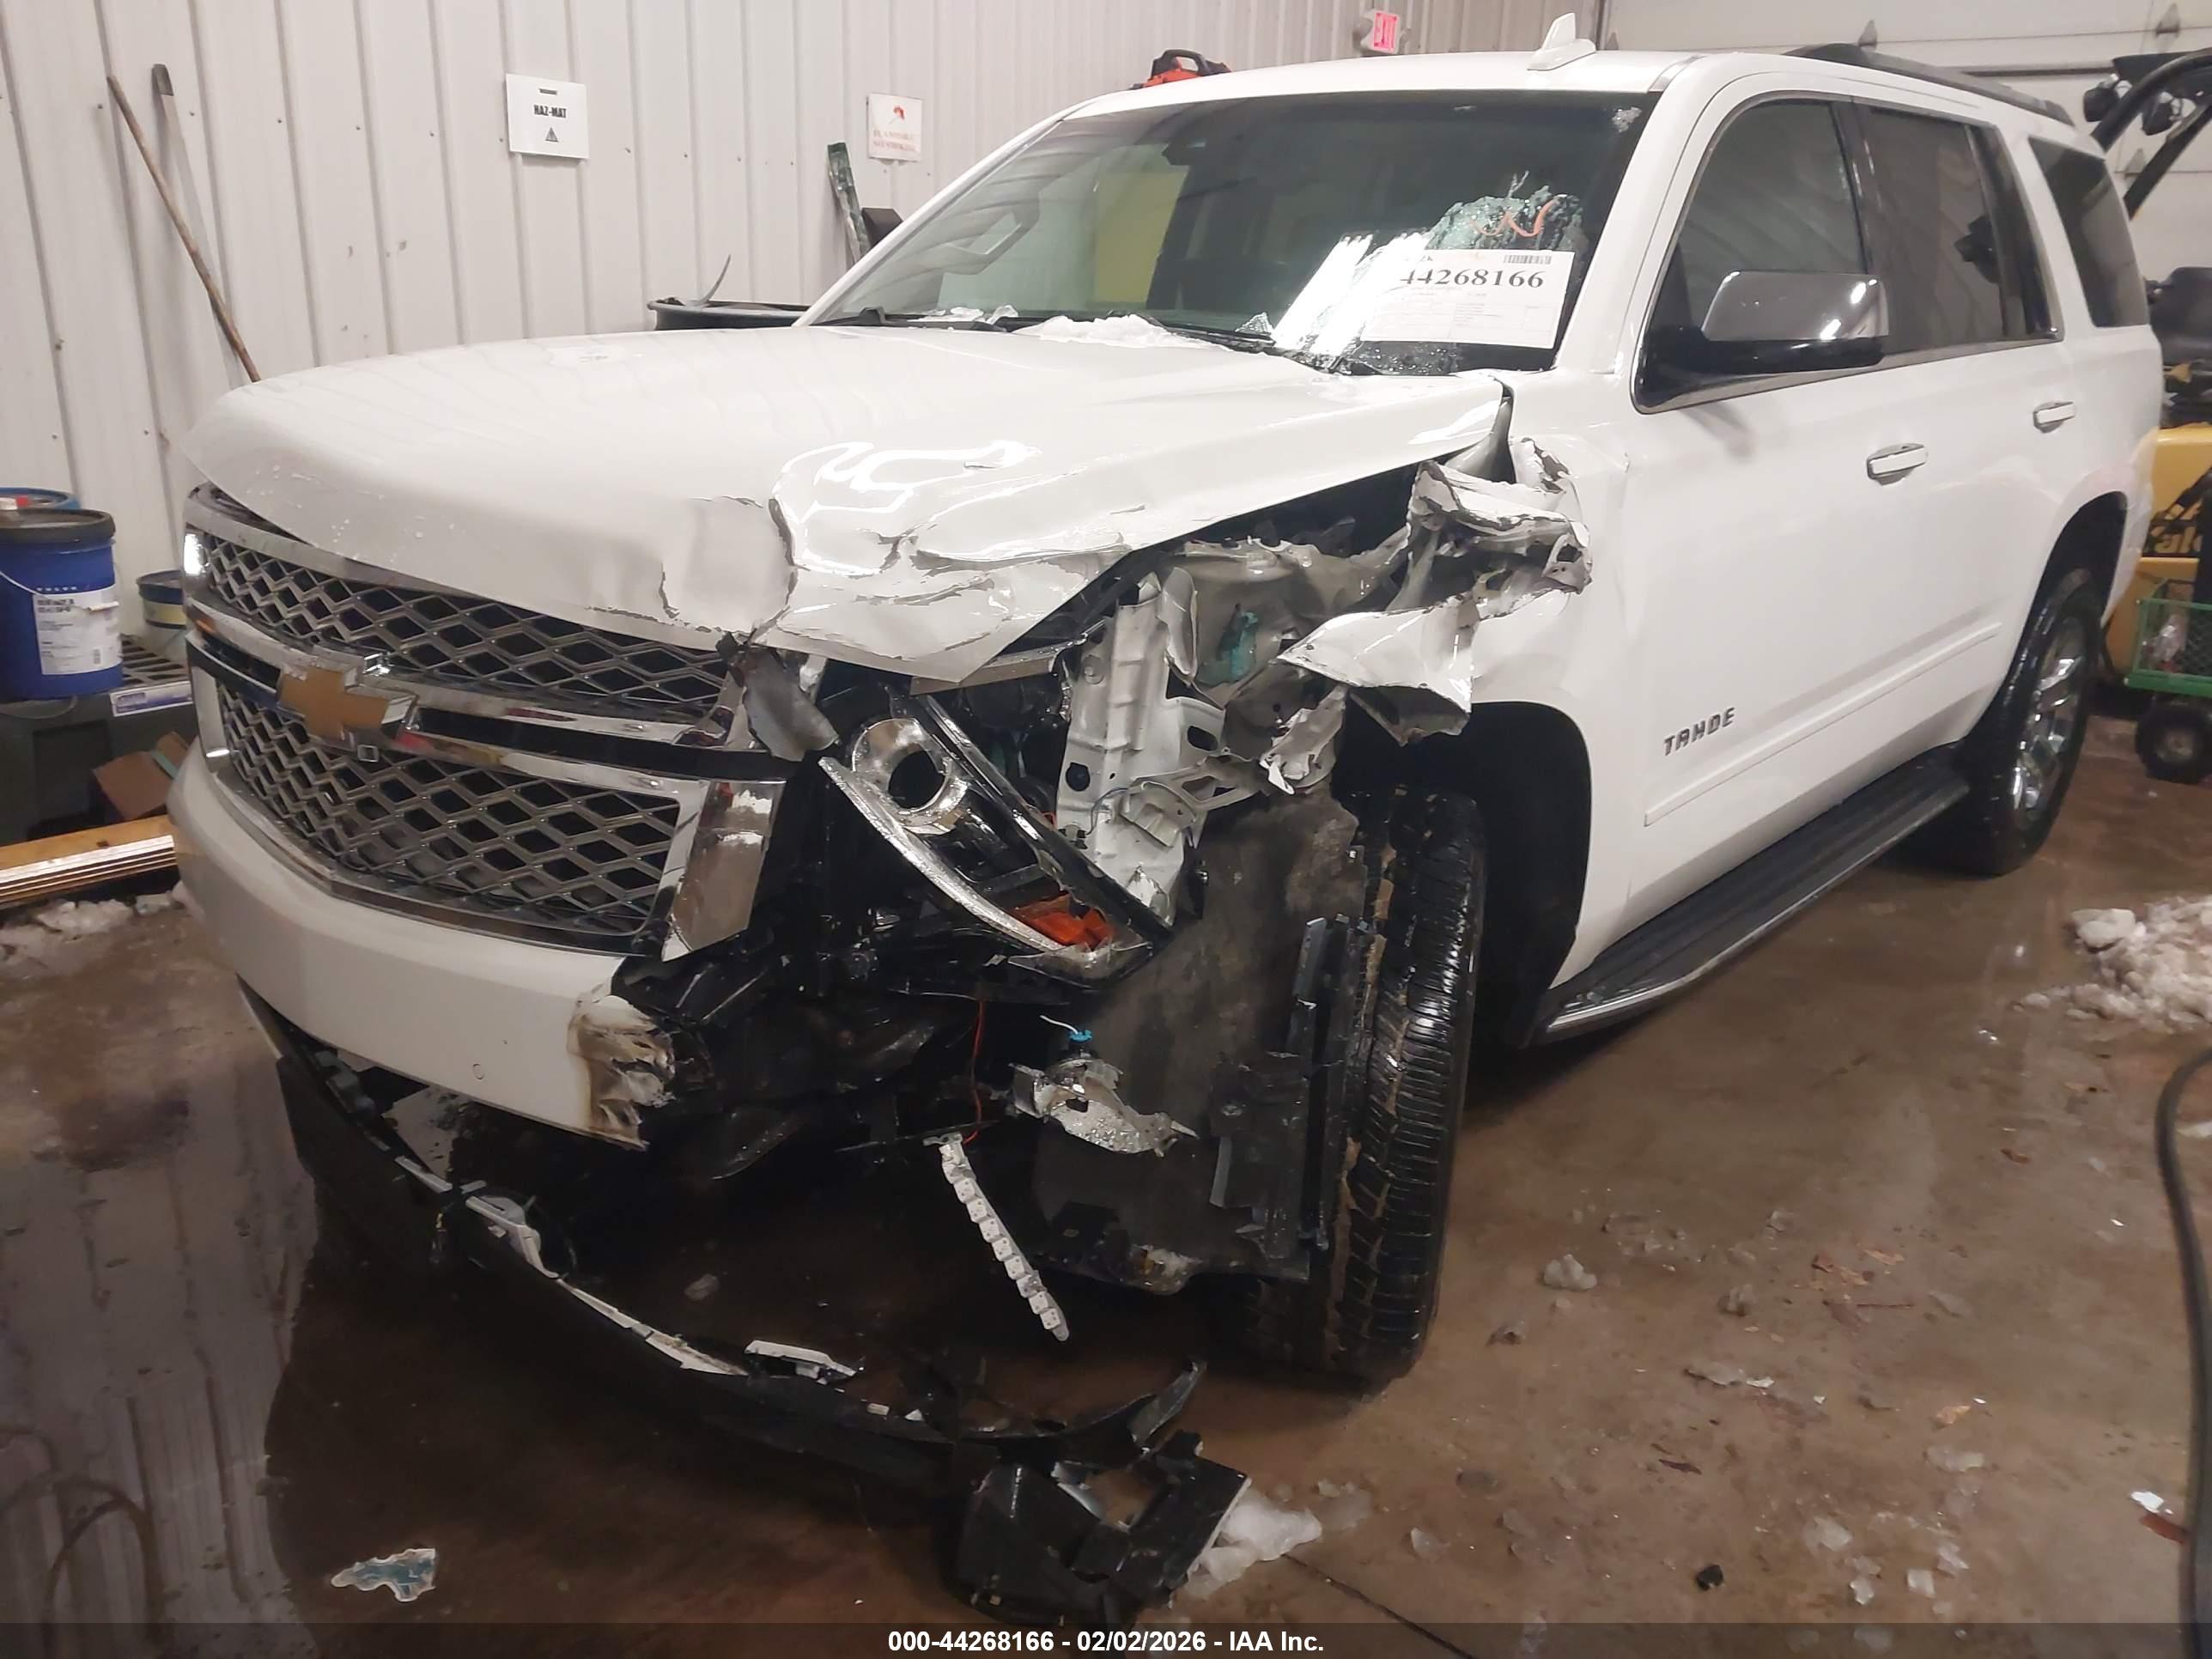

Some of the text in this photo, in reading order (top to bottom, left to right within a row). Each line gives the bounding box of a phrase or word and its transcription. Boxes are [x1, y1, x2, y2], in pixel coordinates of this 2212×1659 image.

[533, 104, 567, 118] HAZ-MAT
[1400, 268, 1545, 289] 44268166
[1664, 707, 1735, 757] TAHOE
